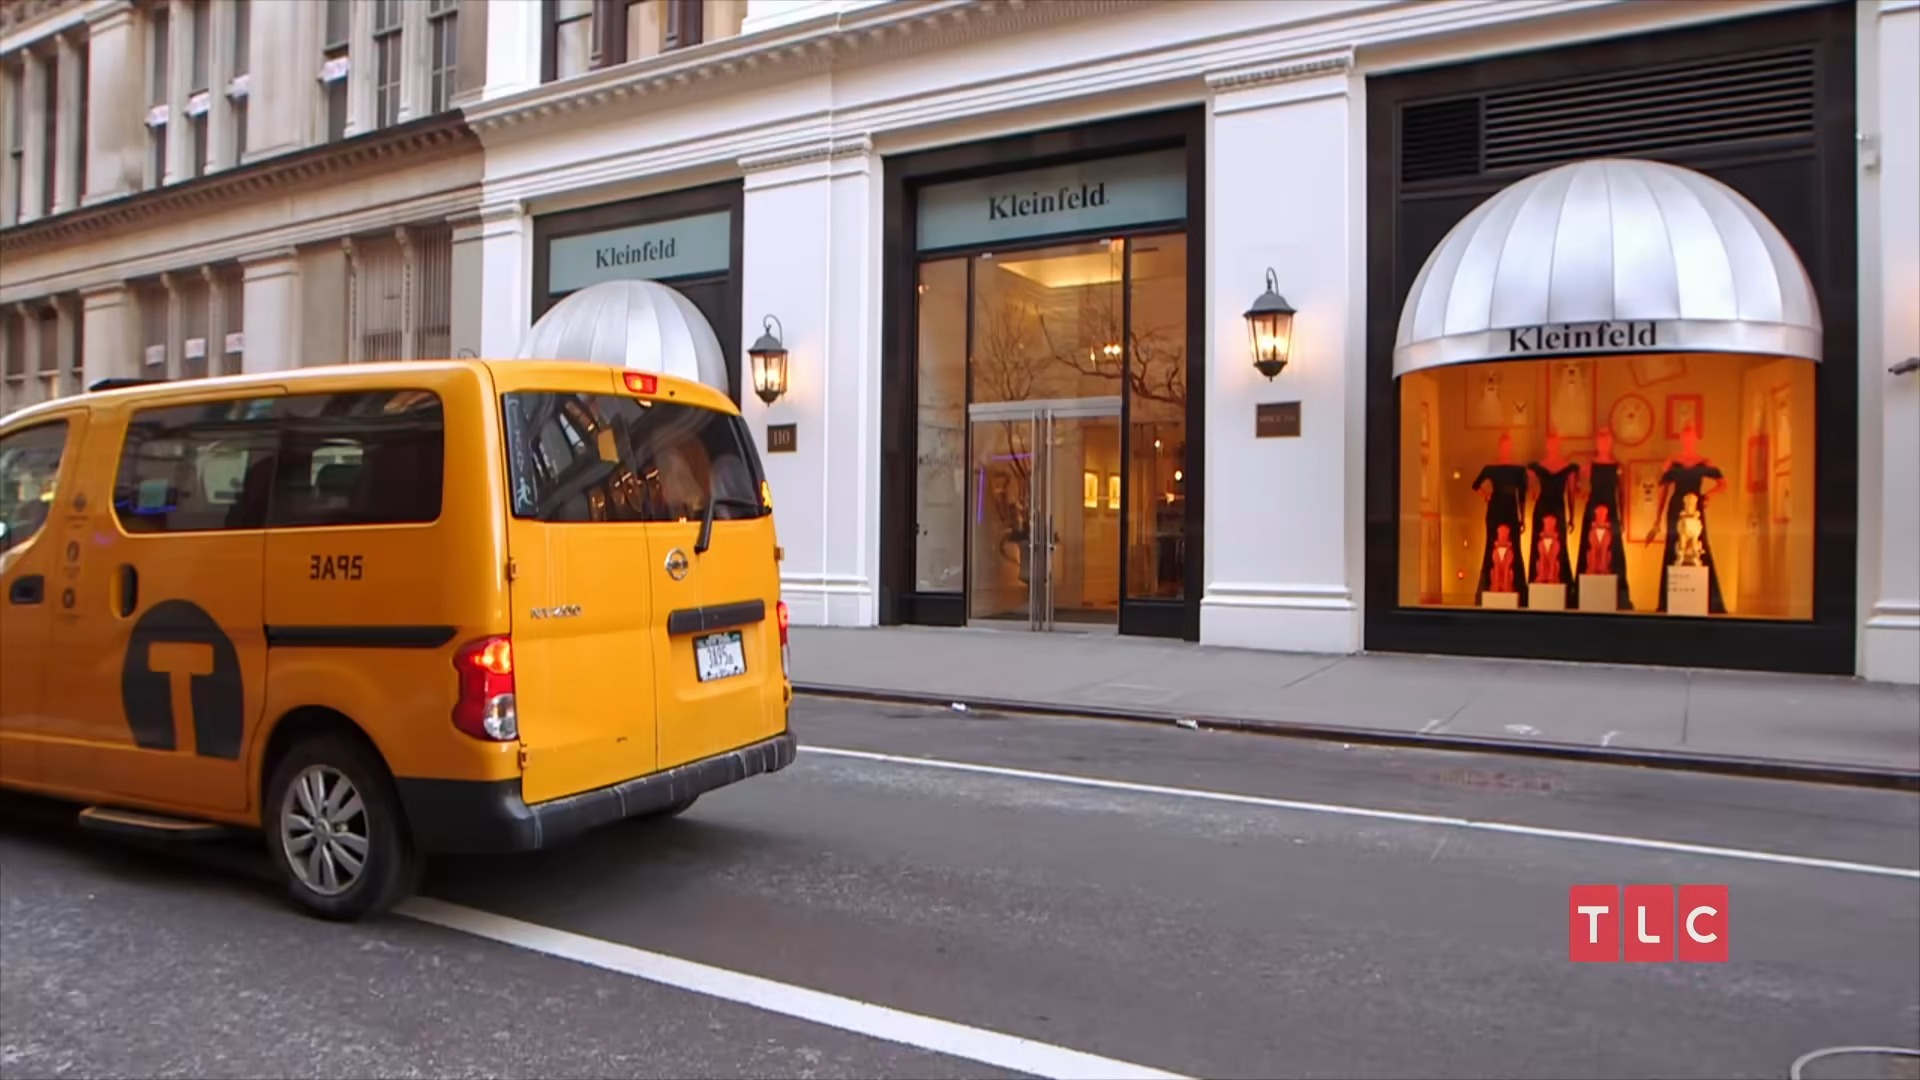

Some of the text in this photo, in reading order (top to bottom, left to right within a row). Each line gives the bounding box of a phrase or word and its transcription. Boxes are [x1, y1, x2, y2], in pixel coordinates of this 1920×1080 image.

[988, 182, 1105, 220] Kleinfeld
[595, 237, 676, 269] Kleinfeld
[1509, 321, 1656, 352] Kleinfeld
[310, 554, 363, 581] 3A95
